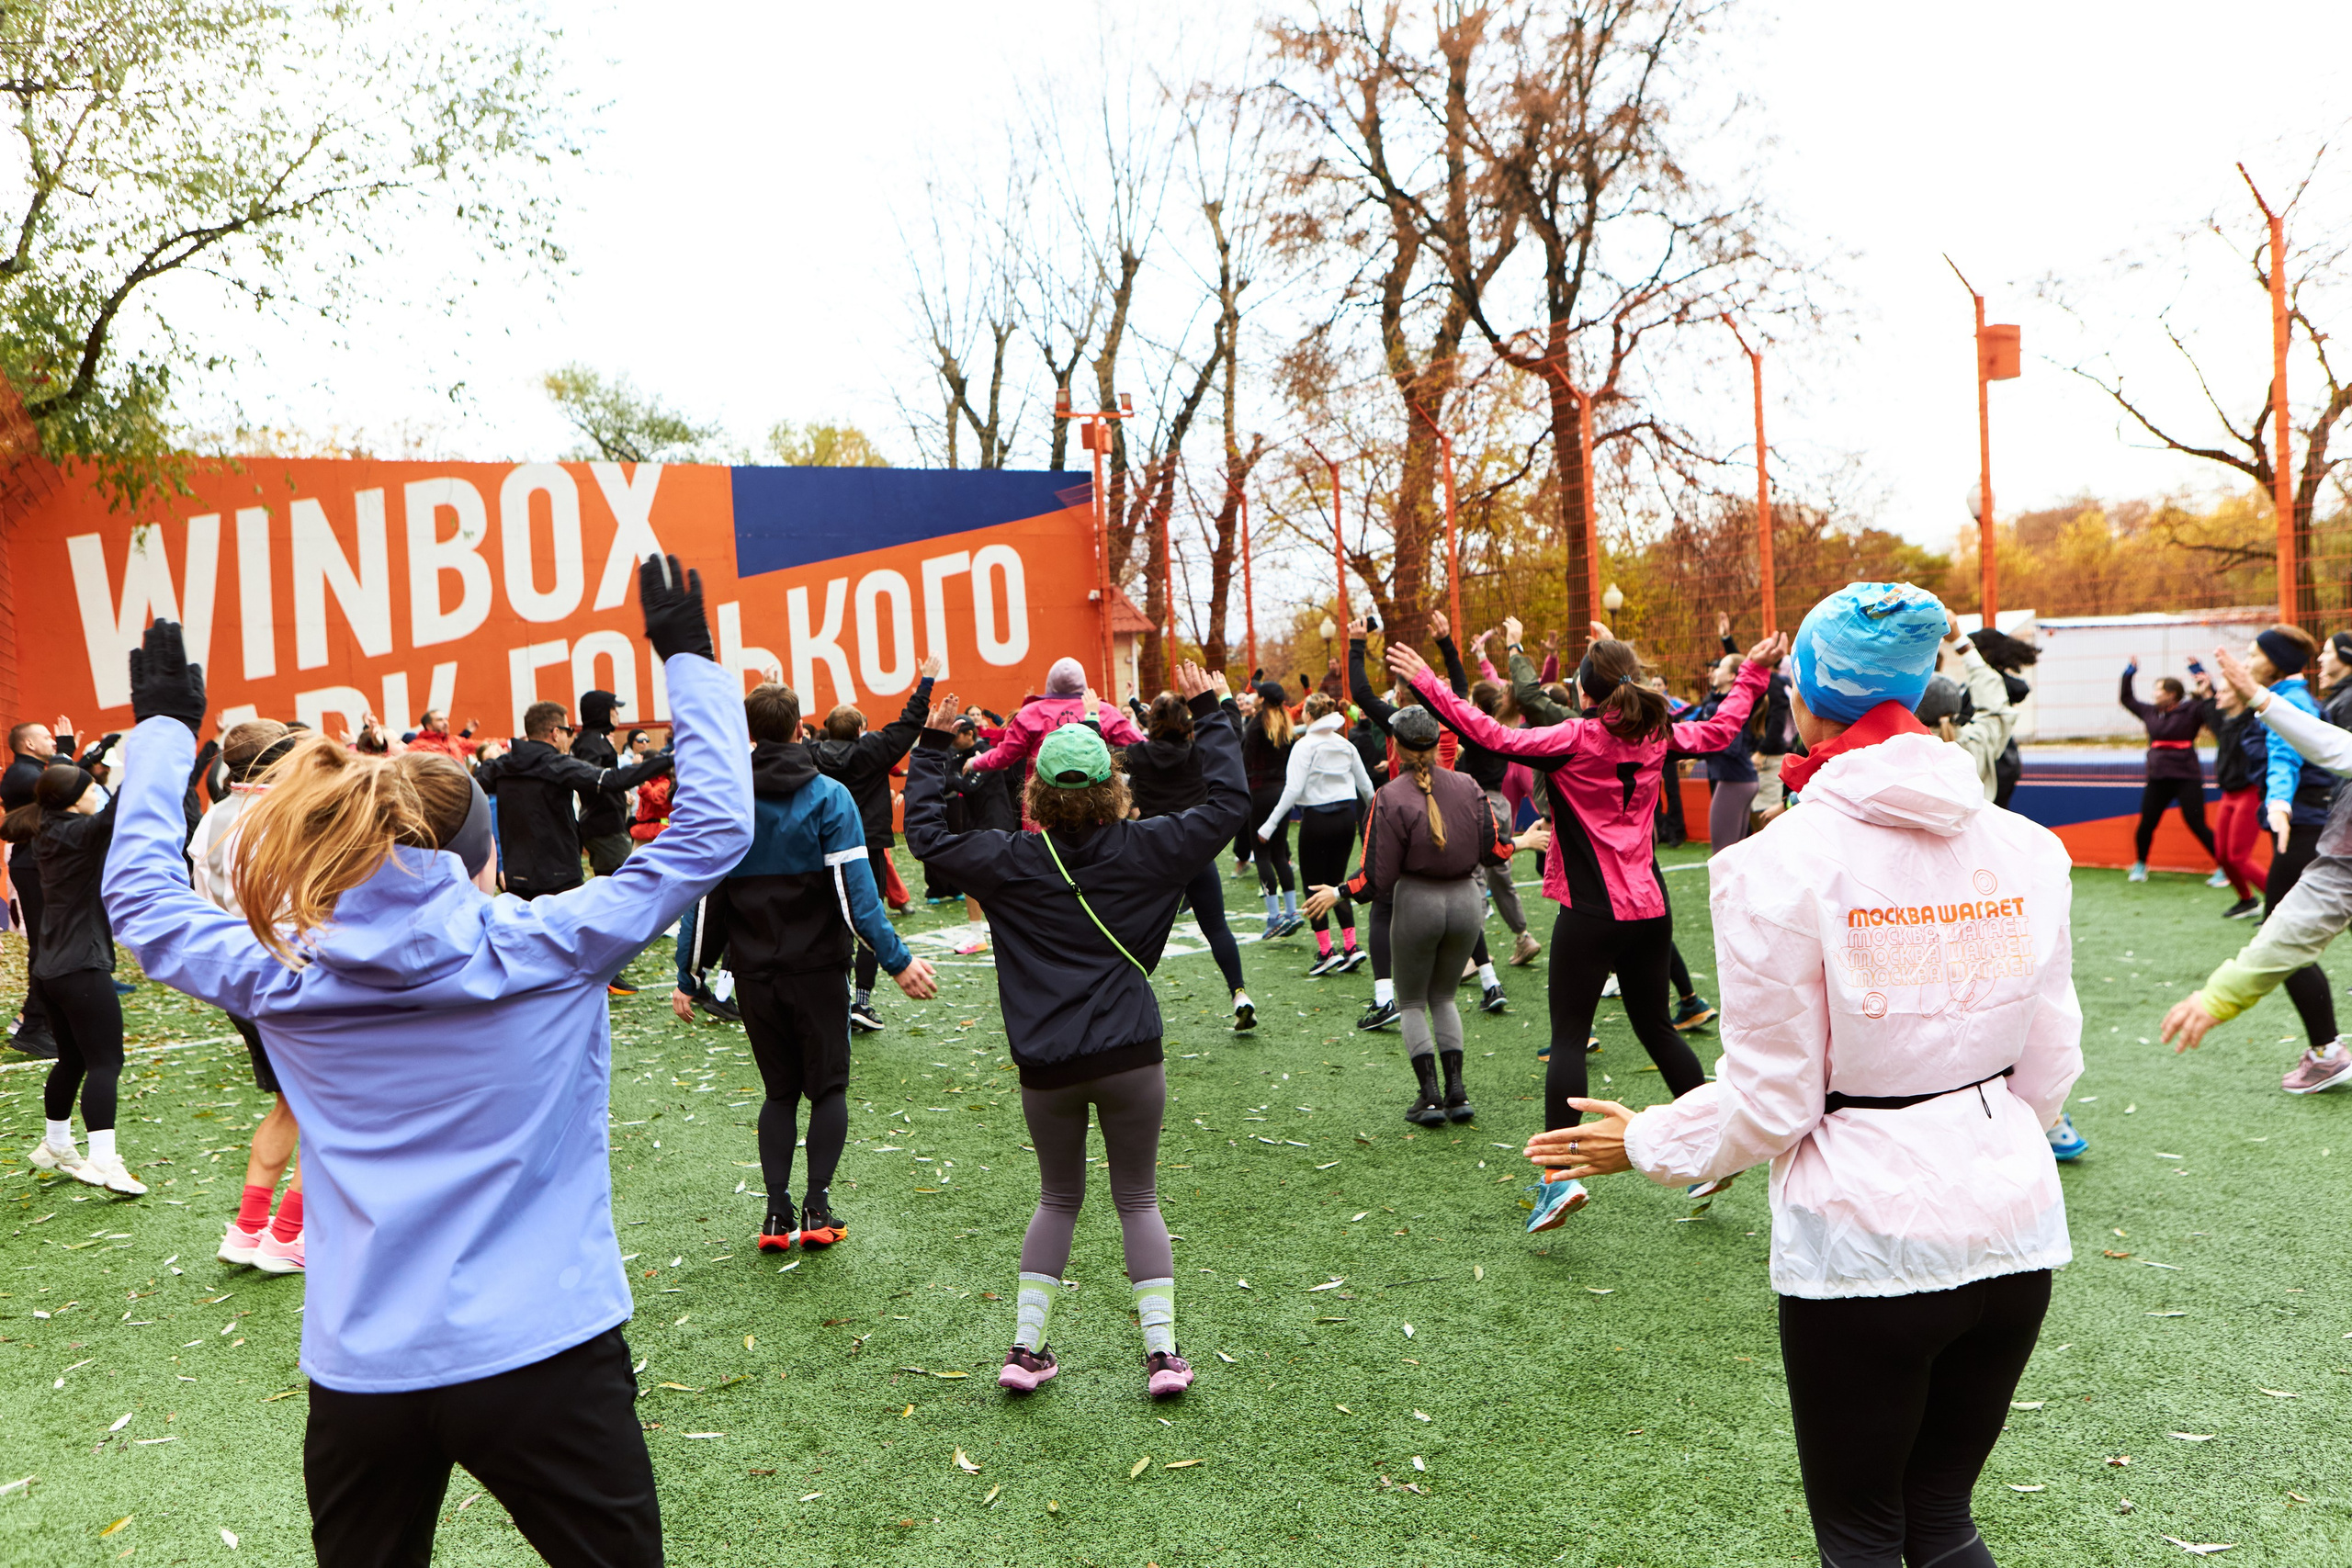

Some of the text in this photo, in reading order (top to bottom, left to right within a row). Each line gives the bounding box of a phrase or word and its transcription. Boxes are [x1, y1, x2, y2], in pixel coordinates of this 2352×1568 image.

[67, 462, 672, 709] WINBOX
[508, 544, 1030, 739] ГОЬКОГО
[1848, 897, 2025, 928] МОСКВА ШАГАЕТ
[1848, 916, 2030, 948] МОСКВА ШАГАЕТ
[1849, 935, 2033, 967] МОСКВА ШАГАЕТ
[1851, 955, 2036, 987] МОСКВА ШАГАЕТ
